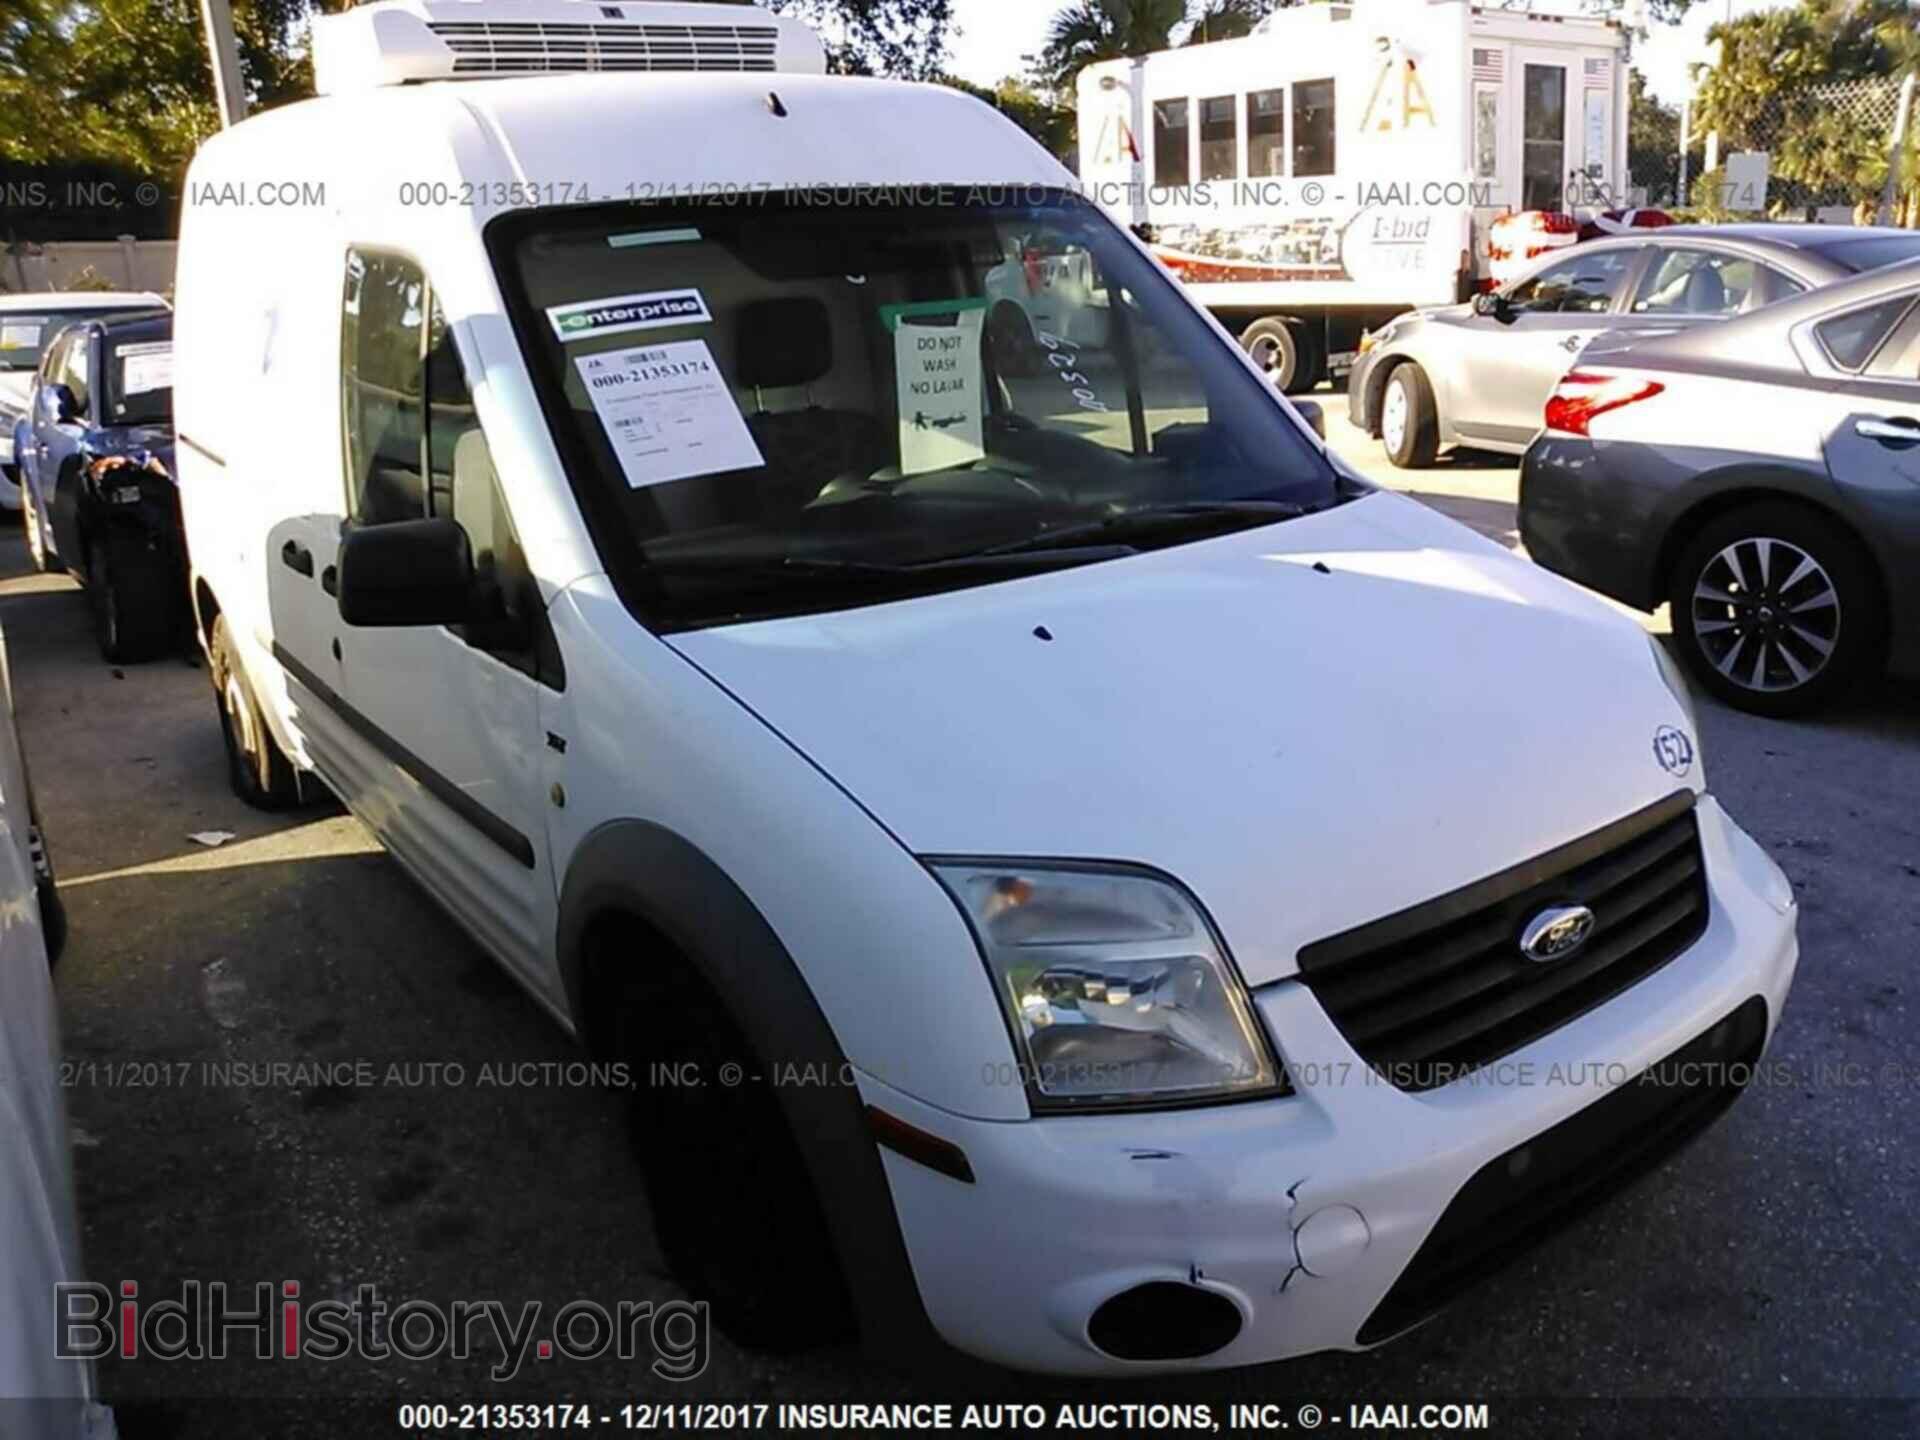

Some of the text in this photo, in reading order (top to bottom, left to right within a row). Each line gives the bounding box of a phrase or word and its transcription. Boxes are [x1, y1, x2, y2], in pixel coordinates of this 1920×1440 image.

[560, 298, 699, 329] enterprise
[917, 336, 962, 352] DO NOT
[923, 359, 957, 373] WASH
[592, 360, 710, 389] 000-21353174
[911, 382, 930, 395] NO
